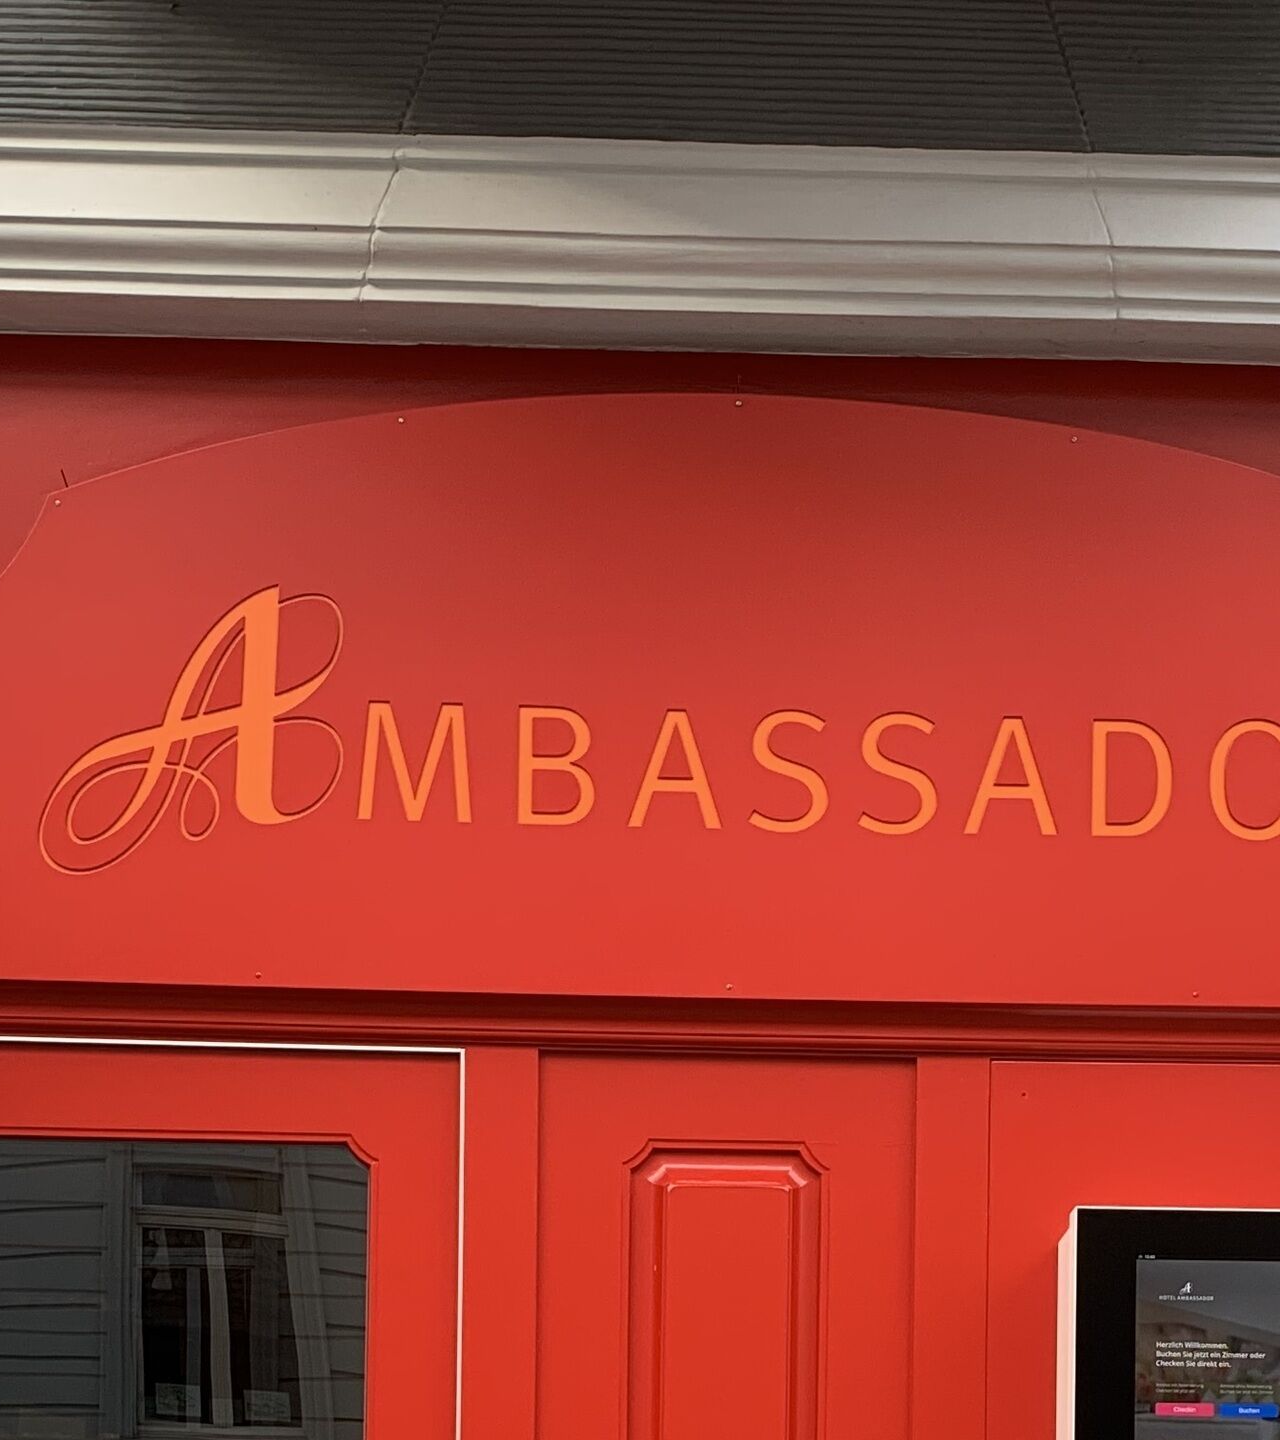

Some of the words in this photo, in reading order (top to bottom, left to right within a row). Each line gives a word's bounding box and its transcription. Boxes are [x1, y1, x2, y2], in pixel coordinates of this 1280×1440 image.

[1155, 1341, 1183, 1349] Herzlich
[1155, 1350, 1182, 1358] Buchen
[1193, 1351, 1209, 1360] jetzt
[1222, 1351, 1248, 1359] Zimmer
[1197, 1360, 1218, 1368] direkt
